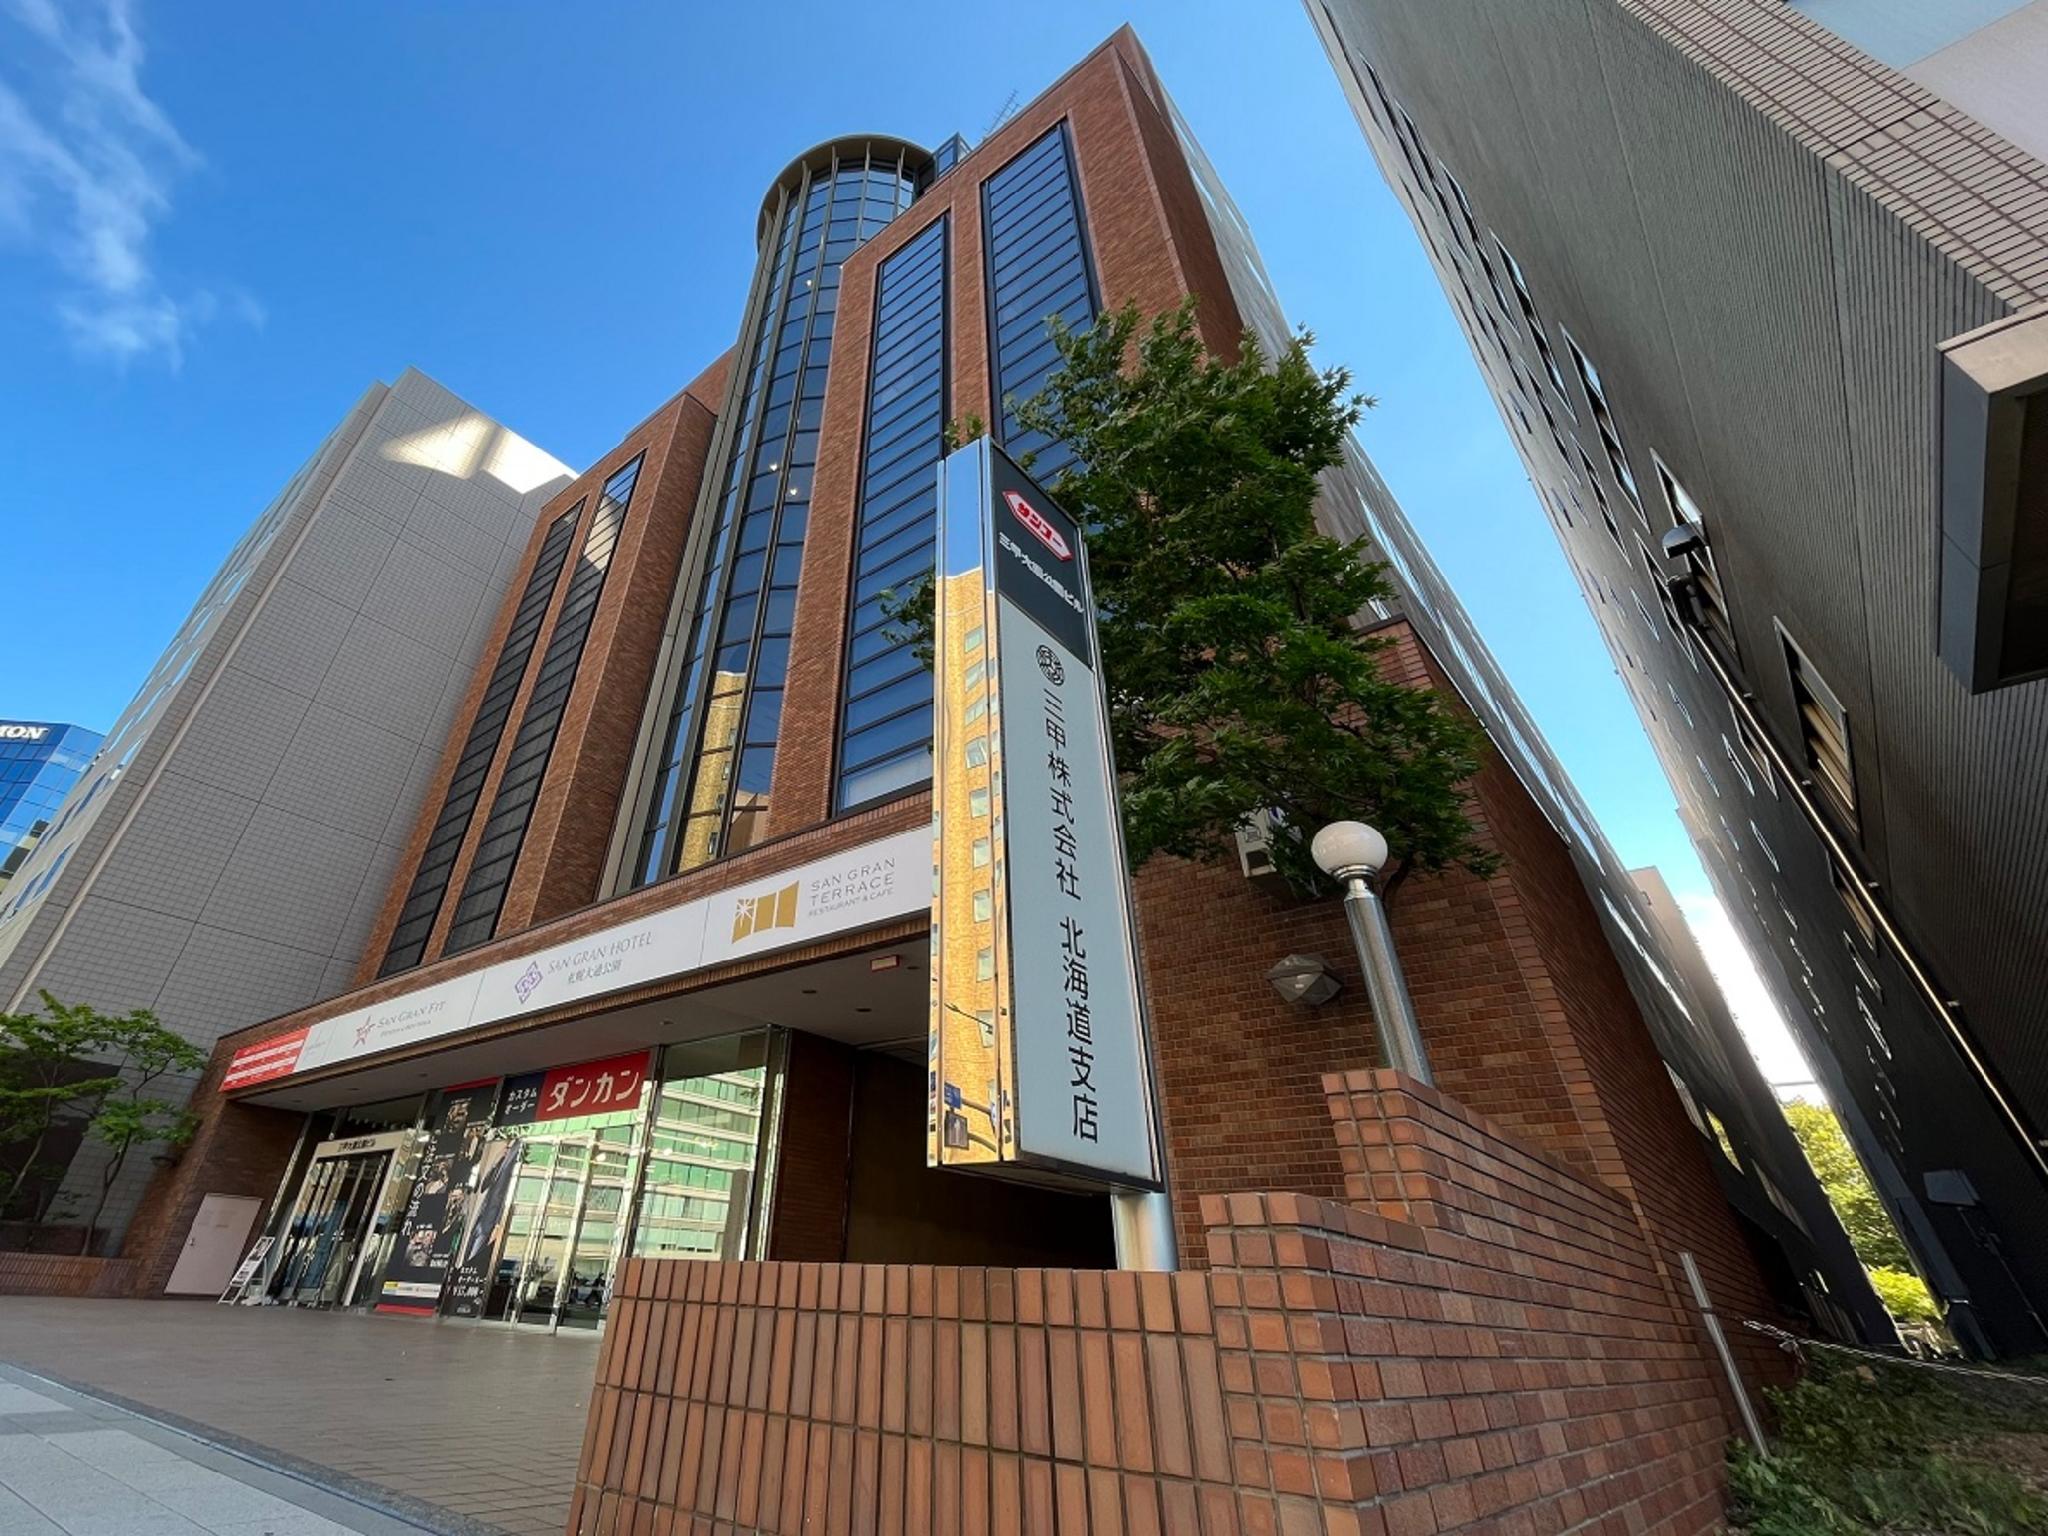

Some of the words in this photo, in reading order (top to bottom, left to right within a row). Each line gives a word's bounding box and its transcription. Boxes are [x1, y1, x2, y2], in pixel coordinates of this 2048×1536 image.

[1017, 502, 1063, 548] サンコー
[1043, 687, 1082, 901] 三甲株式会社
[811, 873, 842, 892] SAN
[847, 857, 895, 881] GRAN
[811, 871, 895, 907] TERRACE
[548, 956, 571, 974] SAN
[573, 945, 607, 966] GRAN
[610, 931, 652, 956] HOTEL
[1059, 916, 1099, 1144] 北海道支店
[504, 1101, 535, 1115] オーダー
[508, 1088, 537, 1102] カスタム
[546, 1070, 639, 1112] ダンカン
